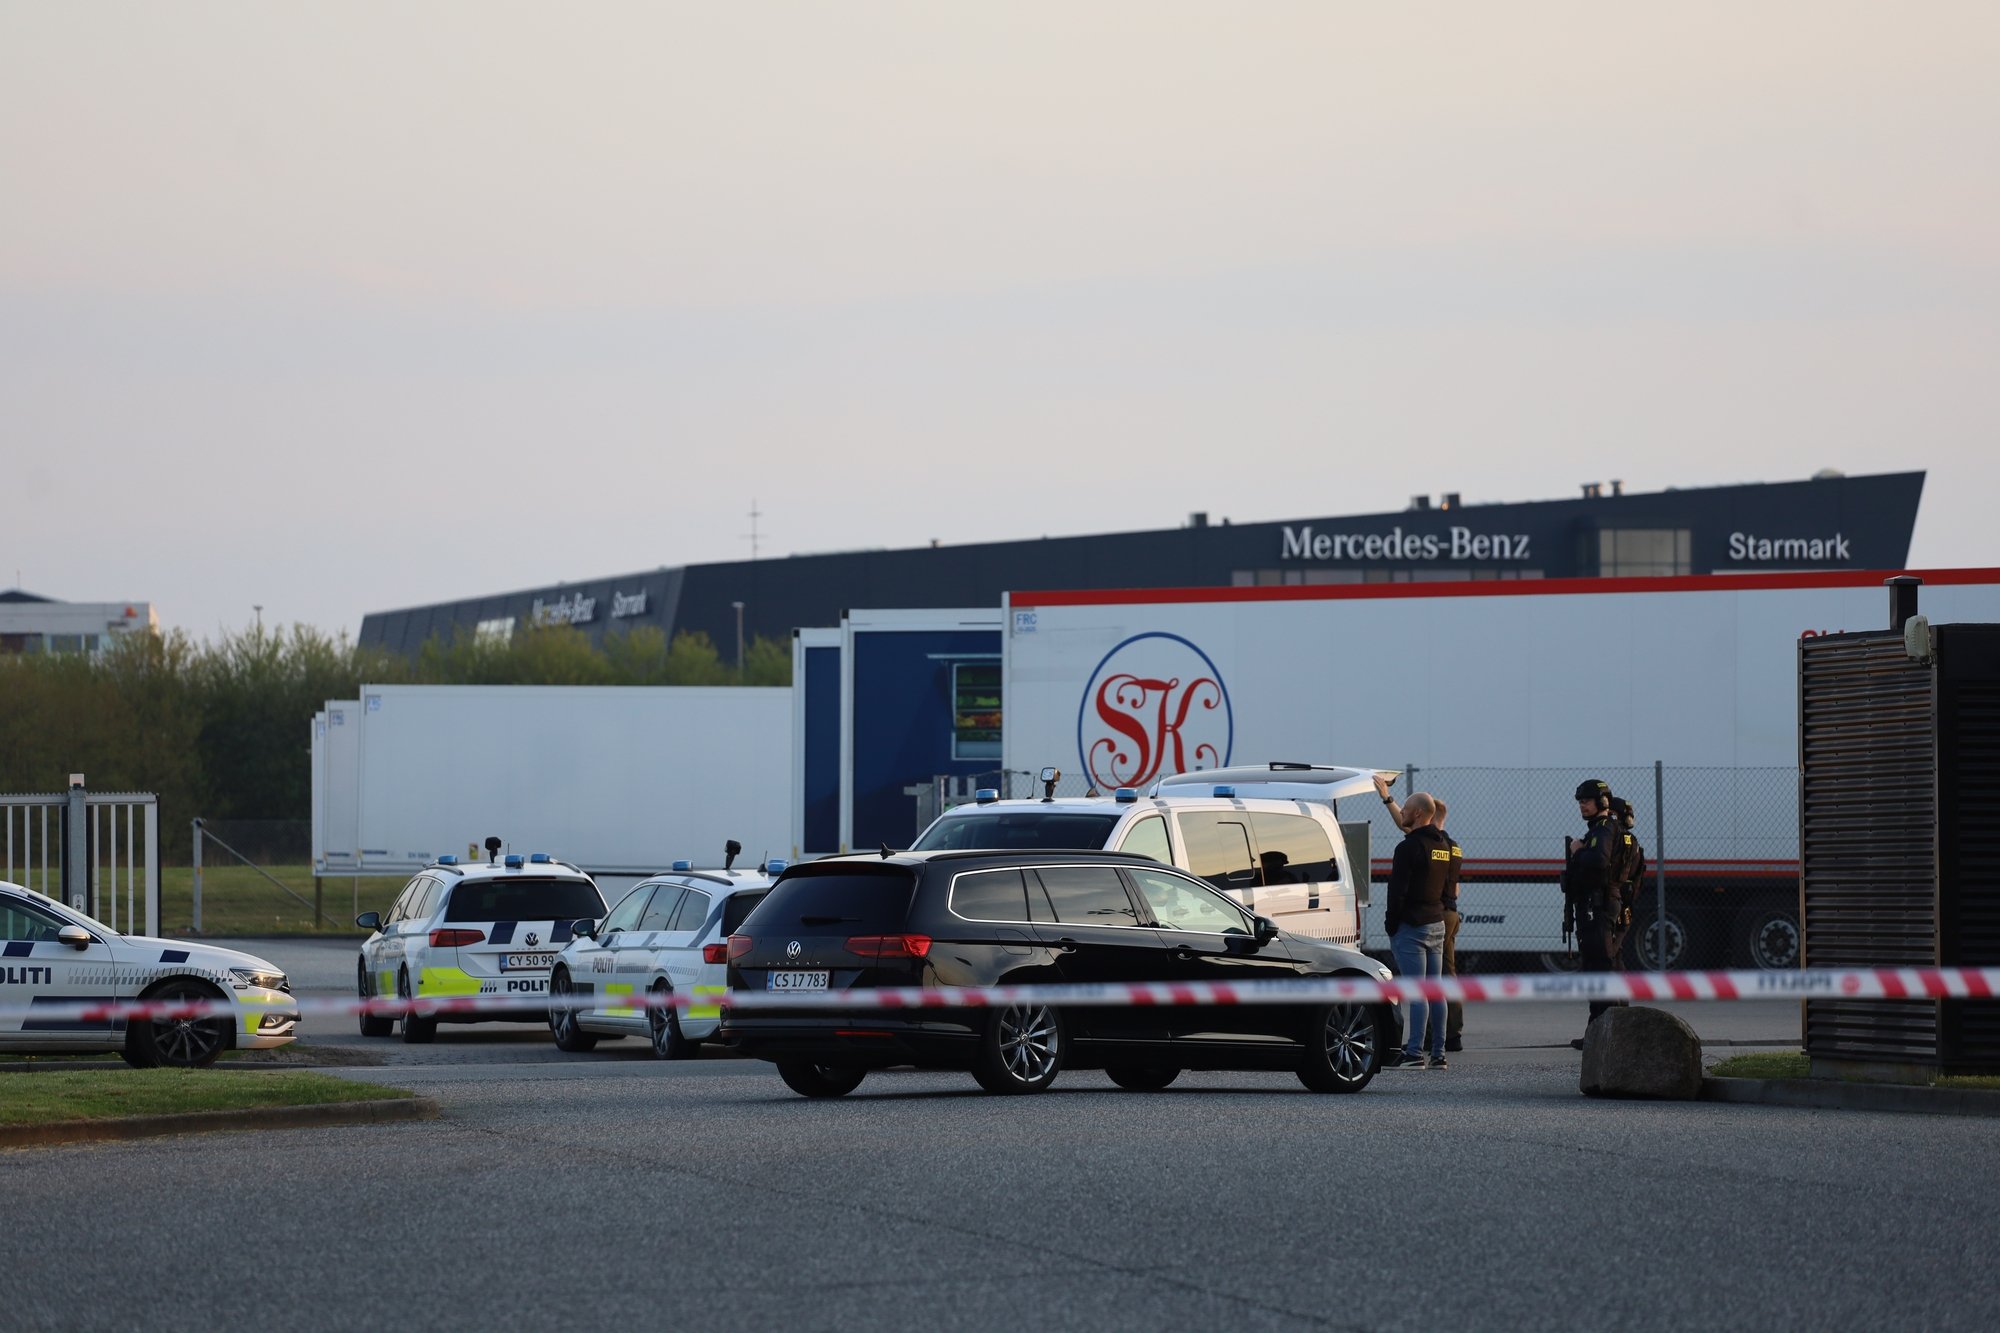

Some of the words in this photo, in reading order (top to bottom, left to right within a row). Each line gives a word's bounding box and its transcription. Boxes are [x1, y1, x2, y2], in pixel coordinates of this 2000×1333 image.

[1281, 526, 1530, 560] Mercedes-Benz
[1728, 532, 1850, 560] Starmark
[1016, 613, 1037, 625] FRC
[1465, 915, 1506, 924] KRONE
[509, 955, 523, 966] CY
[526, 955, 538, 966] 50
[774, 973, 789, 987] CS
[792, 973, 804, 987] 17
[807, 973, 827, 987] 783
